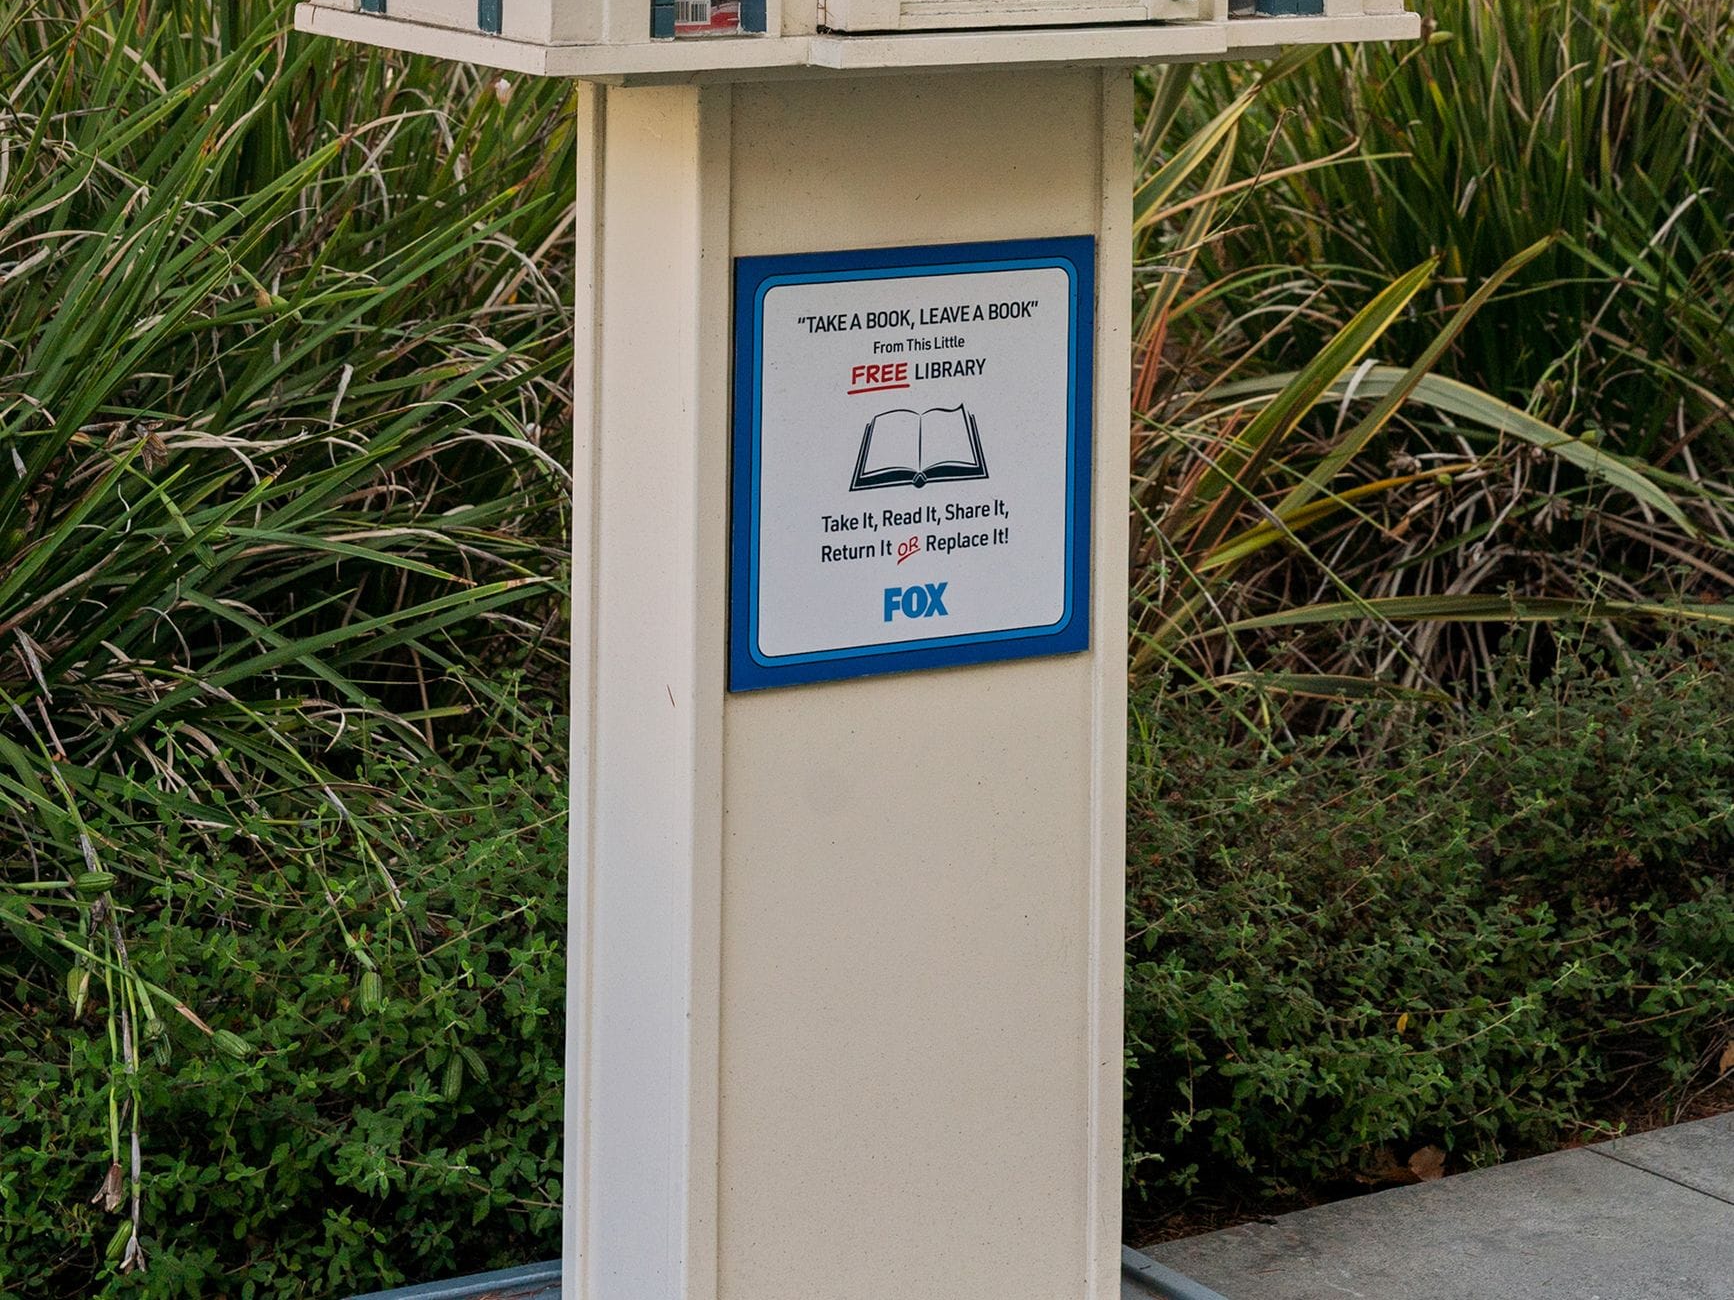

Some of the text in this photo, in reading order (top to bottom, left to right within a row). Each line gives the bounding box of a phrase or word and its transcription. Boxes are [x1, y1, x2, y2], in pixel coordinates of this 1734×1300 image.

[850, 312, 862, 331] A
[866, 309, 915, 330] BOOK,
[919, 305, 970, 325] LEAVE
[972, 304, 985, 322] A
[873, 335, 965, 354] From This Little
[851, 358, 987, 385] FREE LIBRARY
[821, 500, 1010, 533] Take It, Read It, Share It,
[821, 527, 1009, 562] Return It OR Replace It!
[883, 581, 949, 623] FOX
